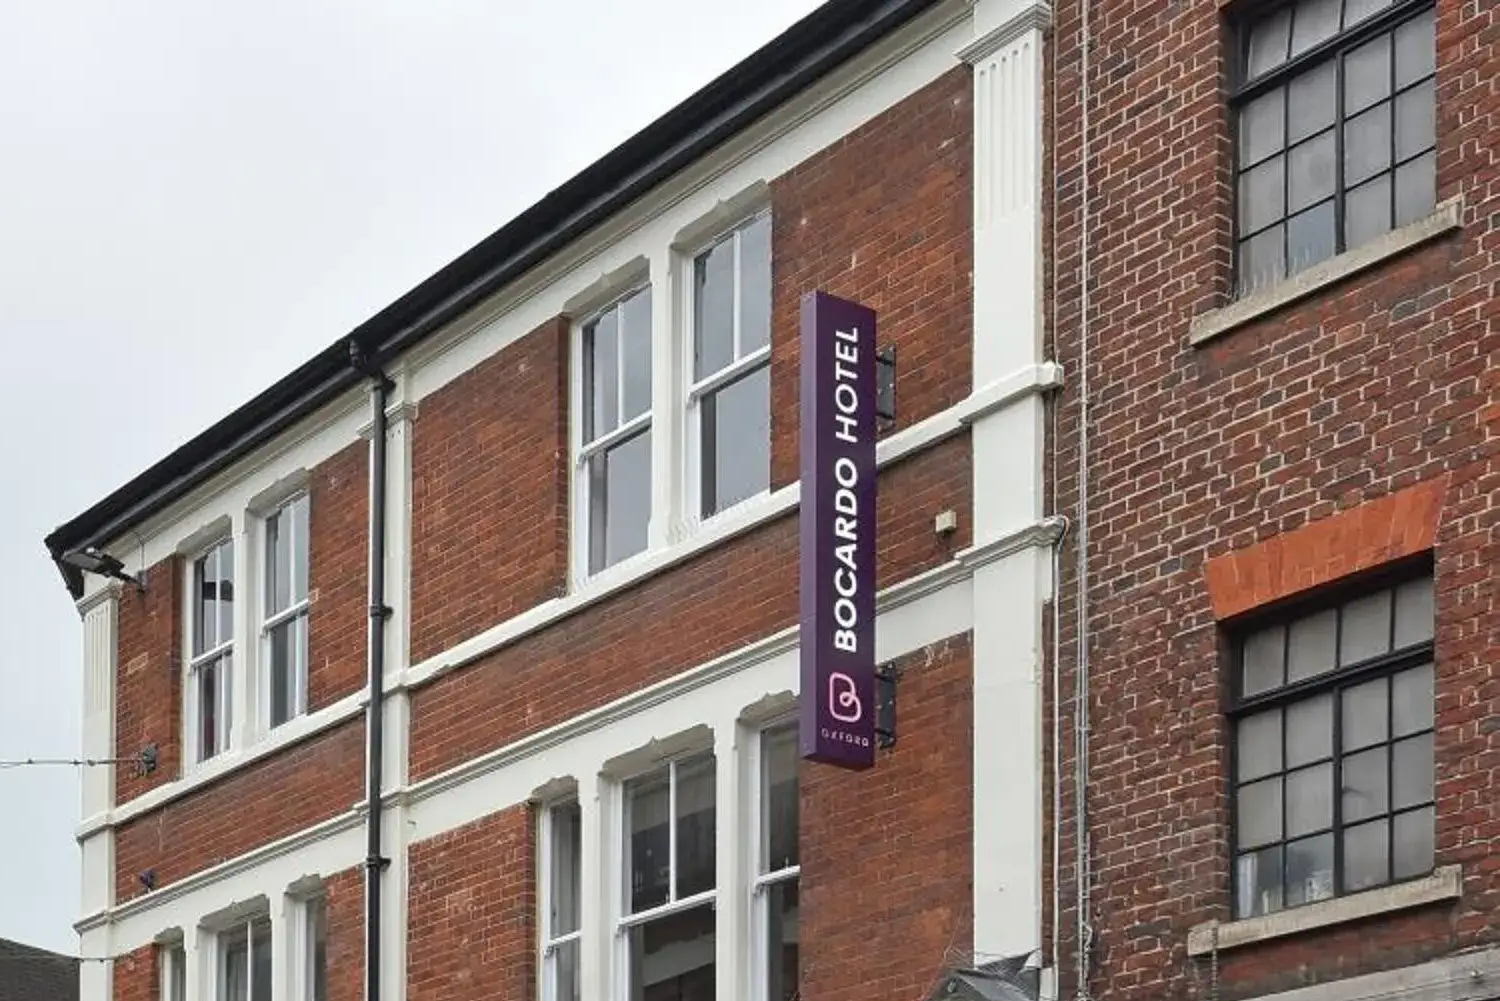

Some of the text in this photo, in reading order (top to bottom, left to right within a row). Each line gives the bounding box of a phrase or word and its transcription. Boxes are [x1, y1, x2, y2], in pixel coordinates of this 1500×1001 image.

[834, 326, 859, 653] BOCARDO HOTEL
[821, 727, 869, 747] OXFORD
